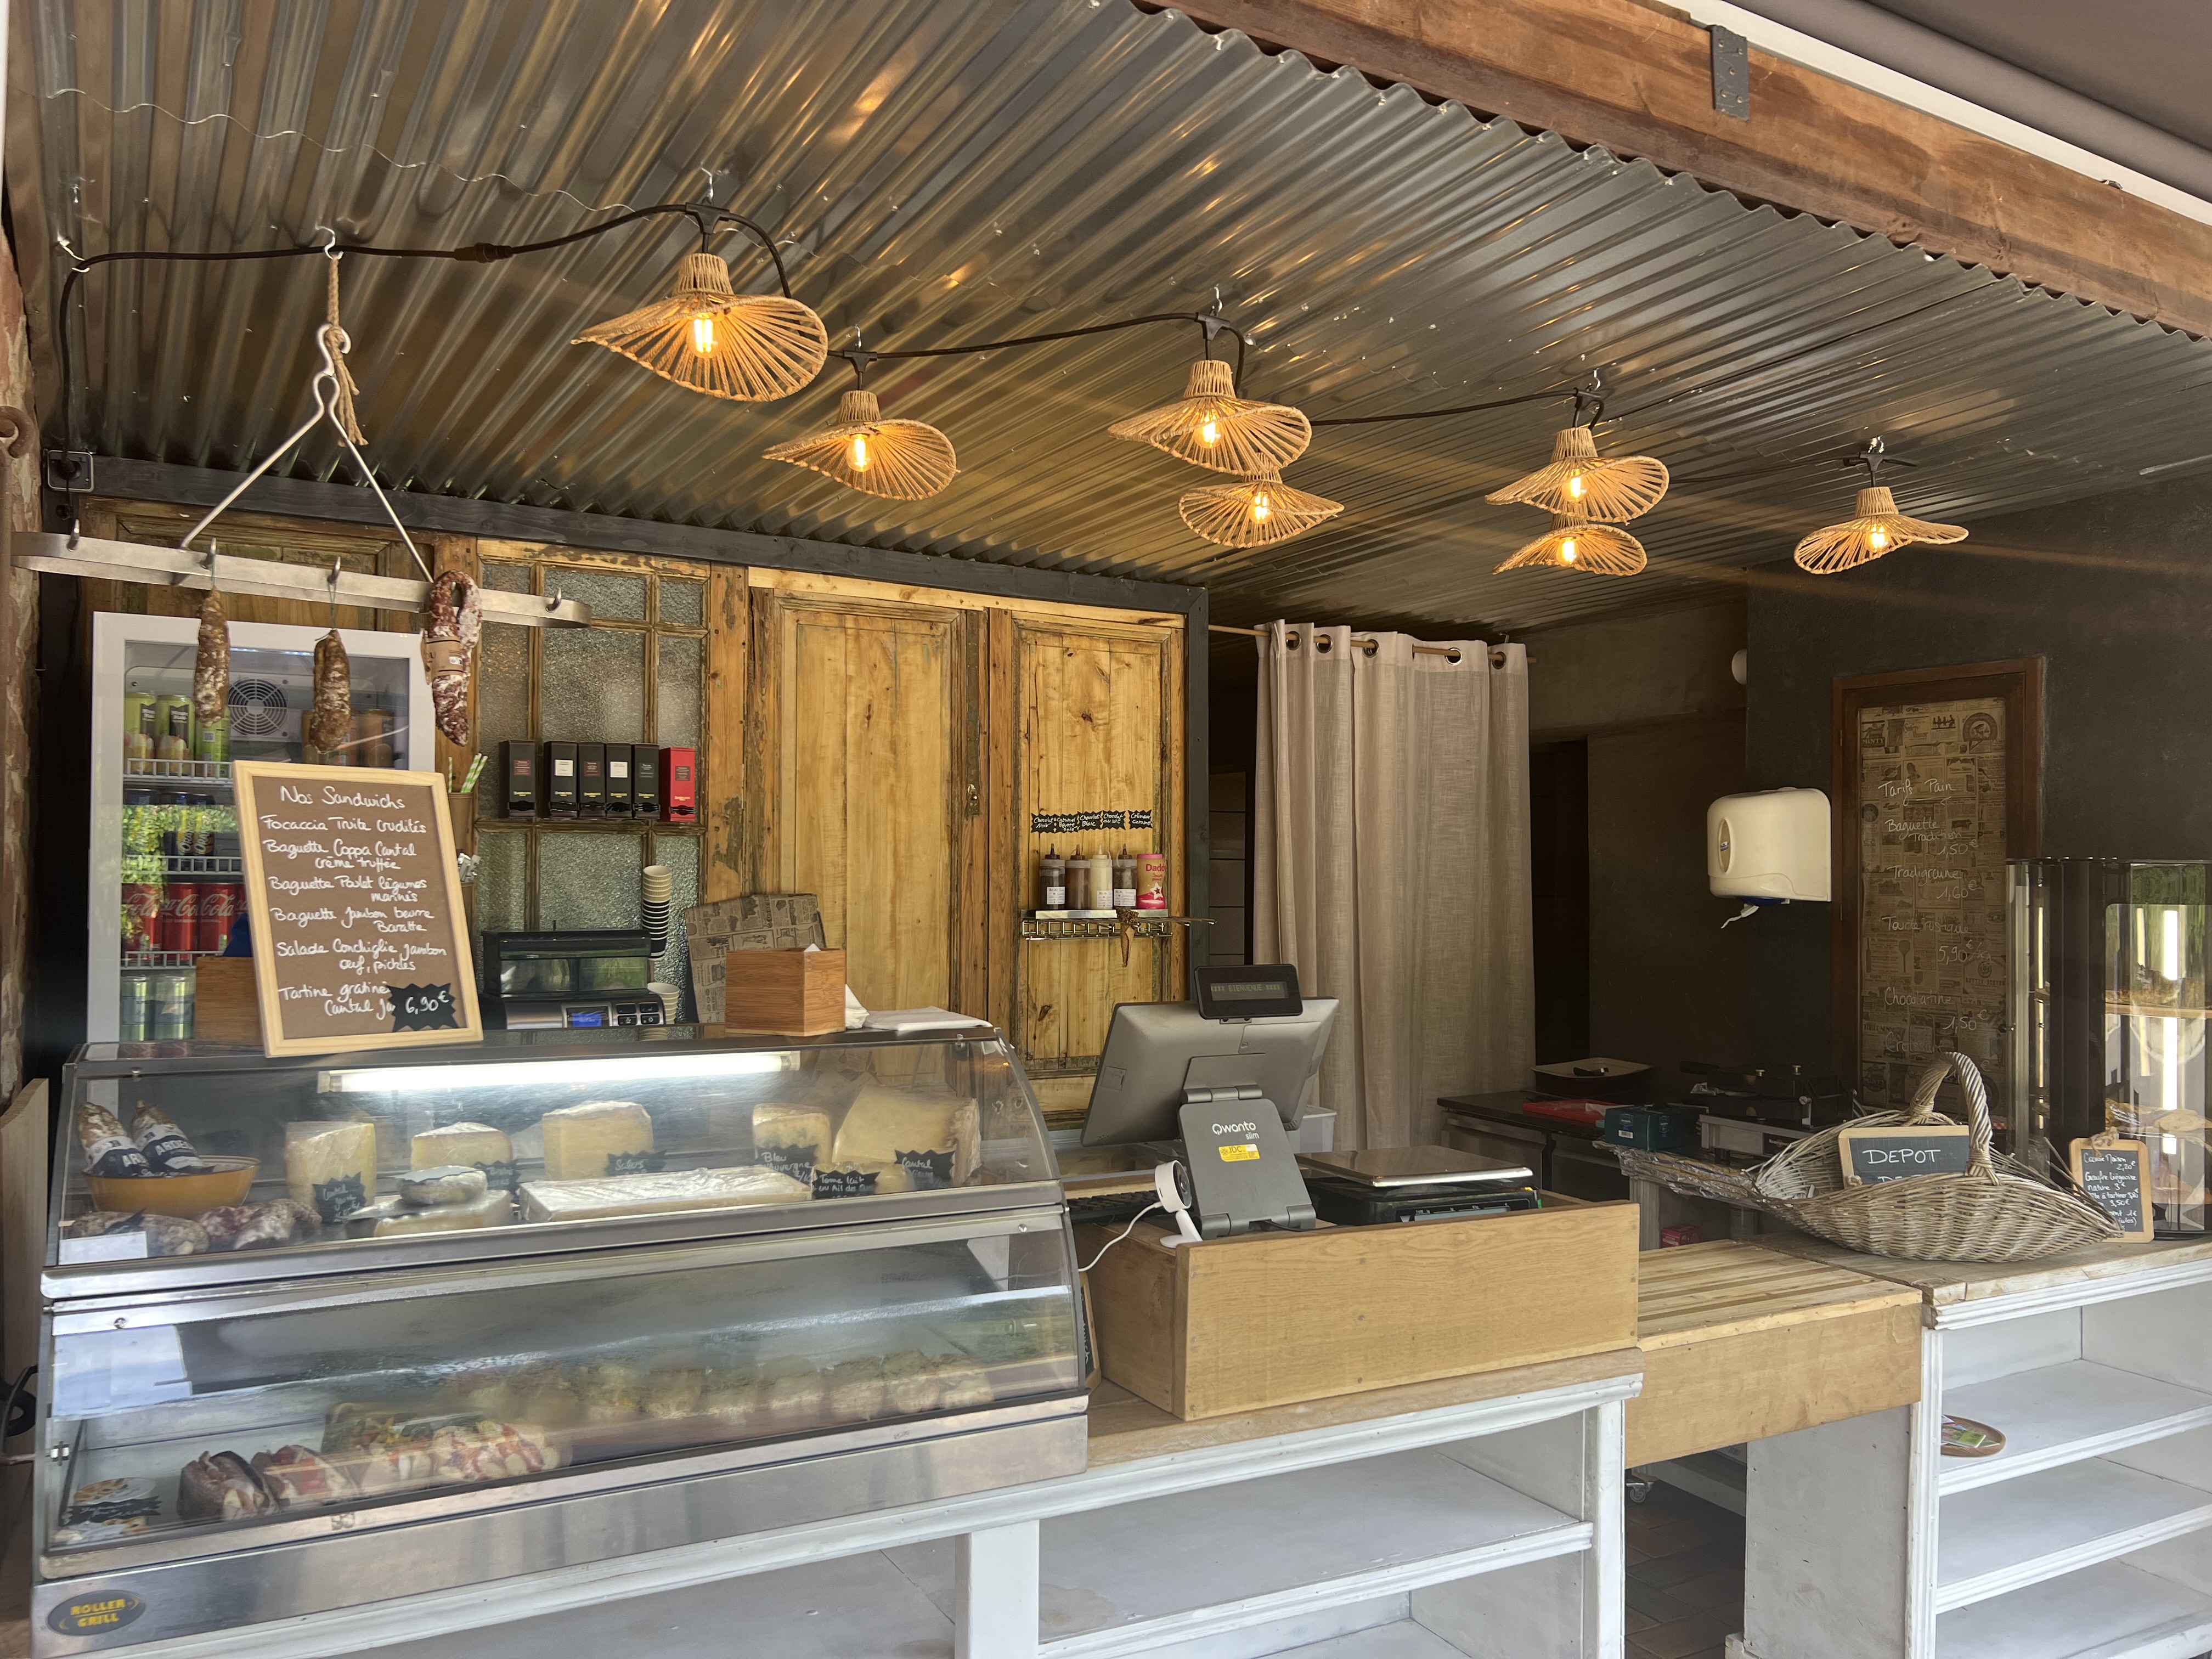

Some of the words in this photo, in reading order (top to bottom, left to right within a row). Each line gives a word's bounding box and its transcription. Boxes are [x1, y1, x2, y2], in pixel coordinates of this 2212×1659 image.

[280, 785, 313, 804] Nos
[321, 786, 405, 809] Sandwichs
[1877, 778, 1913, 806] Tarifs
[1924, 778, 1956, 793] Pain
[259, 814, 328, 831] Focaccia
[328, 817, 371, 831] Truite
[1884, 816, 1940, 840] Baguette
[263, 839, 329, 859] Baguette
[334, 838, 372, 860] Coppa
[375, 840, 417, 856] Cantal
[268, 876, 335, 895] Baguette
[270, 907, 336, 928] Baguette
[276, 940, 329, 957] Salade
[277, 984, 333, 1000] Tartine
[1884, 987, 1955, 1006] Chocolatine
[324, 998, 374, 1016] Cantal
[405, 990, 450, 1015] 6,90€
[1212, 1121, 1256, 1135] Qwanto
[761, 1152, 787, 1163] Bleu
[1862, 1148, 1941, 1164] DEPOT
[820, 1174, 843, 1183] Tome
[70, 1599, 126, 1616] ROLLER
[77, 1613, 120, 1627] GRILL
